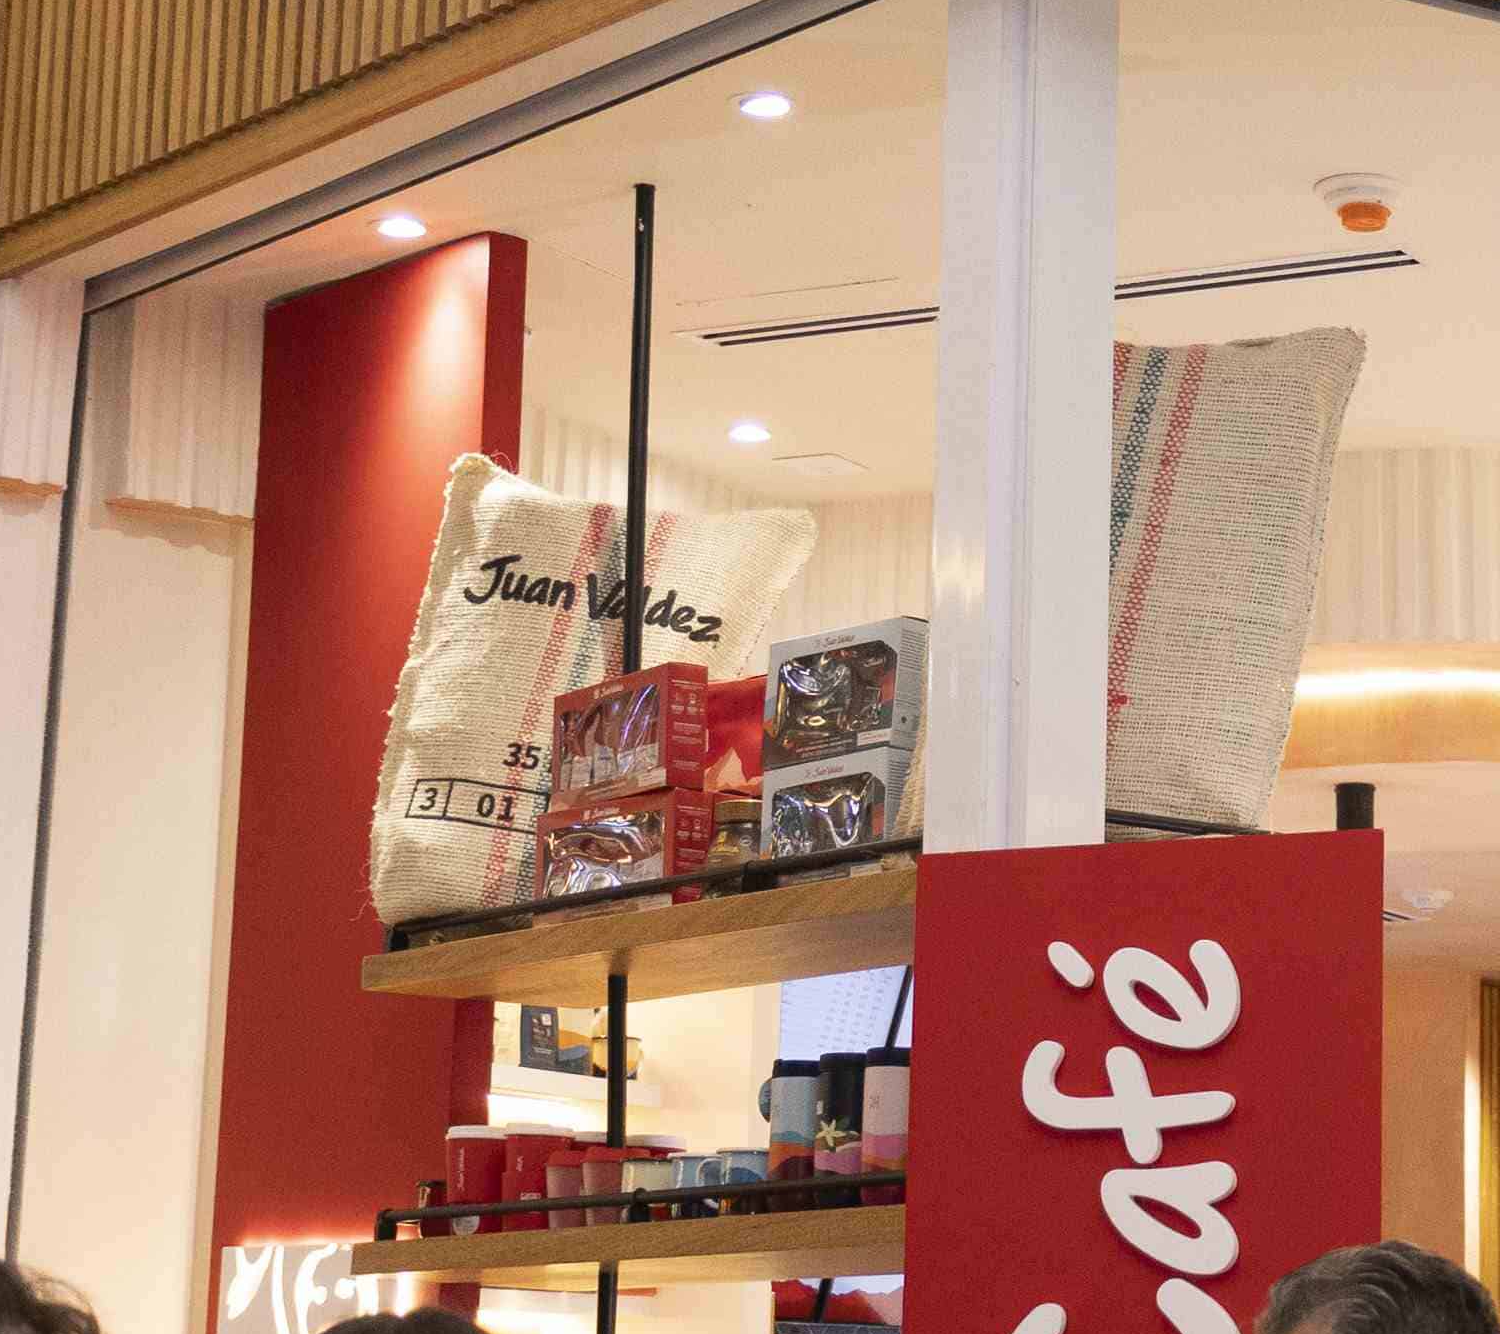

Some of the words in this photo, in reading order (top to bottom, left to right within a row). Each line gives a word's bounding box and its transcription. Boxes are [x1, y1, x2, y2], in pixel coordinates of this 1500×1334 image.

[463, 554, 576, 612] Juan
[502, 742, 542, 770] 35
[419, 787, 439, 811] 3
[476, 793, 516, 822] 01
